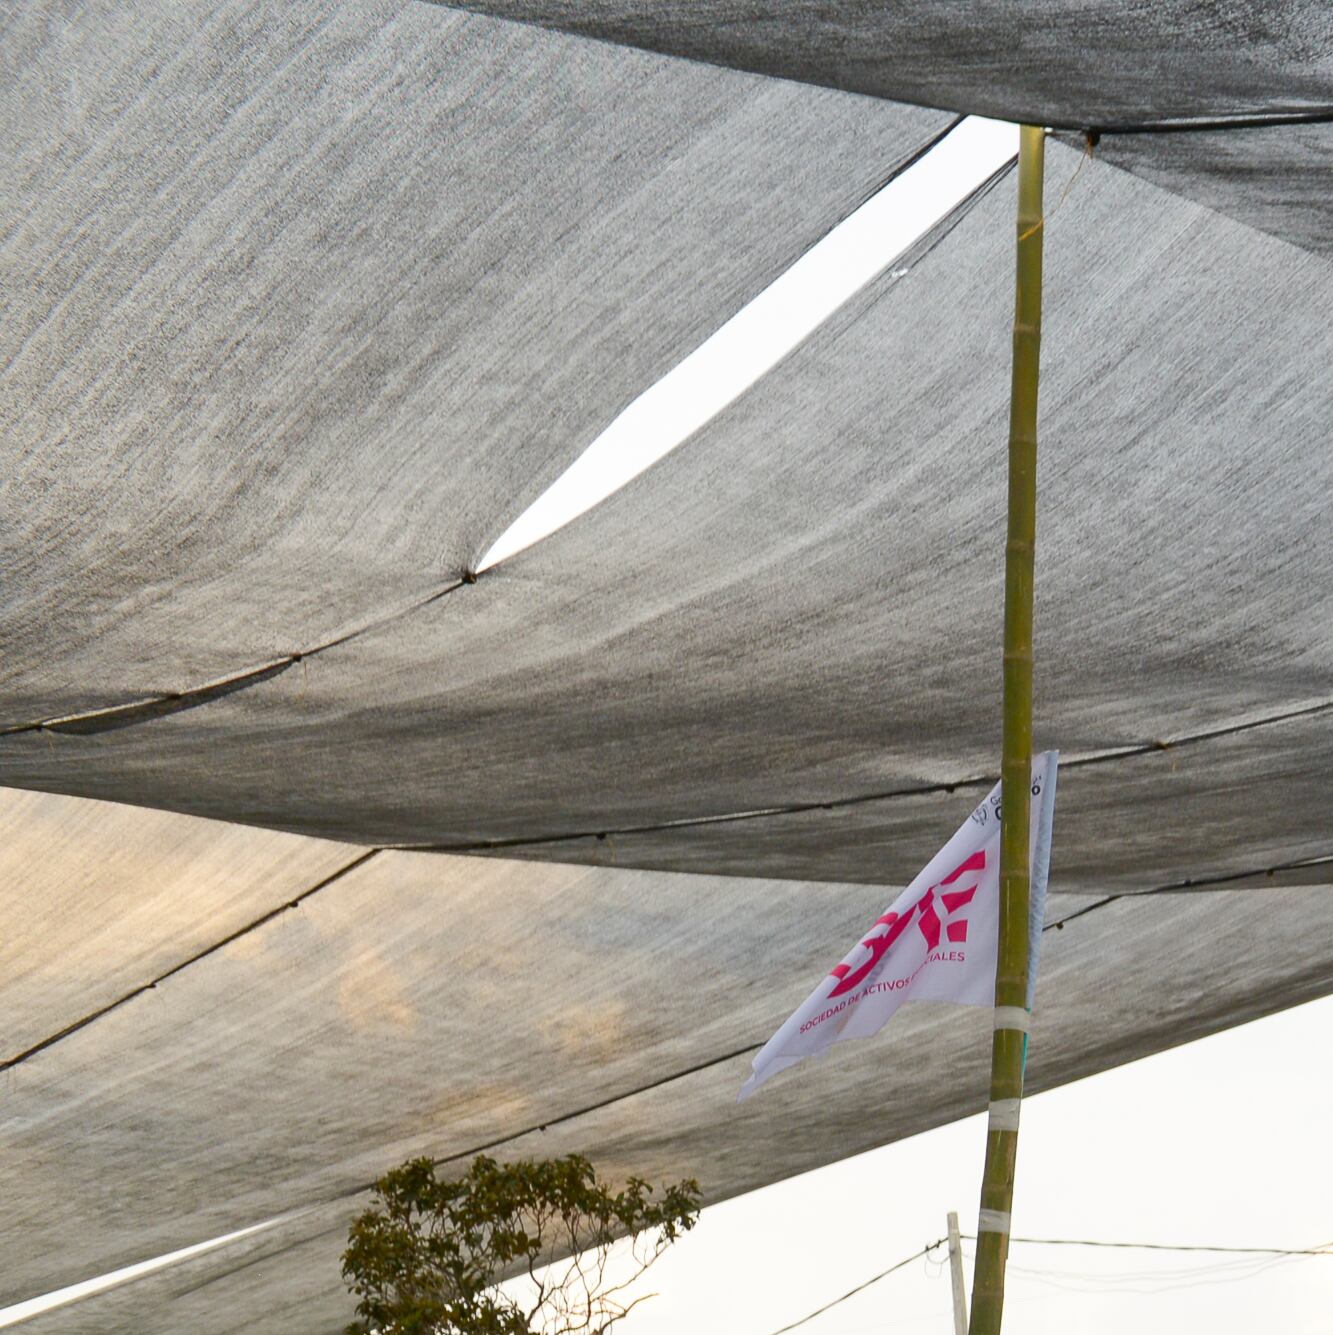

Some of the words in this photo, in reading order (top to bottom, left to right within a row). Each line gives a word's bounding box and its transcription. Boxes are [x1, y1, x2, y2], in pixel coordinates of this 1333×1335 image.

[799, 1000, 847, 1034] SOCIEDAD
[847, 992, 861, 1007] DE
[861, 977, 911, 998] ACTIVOS
